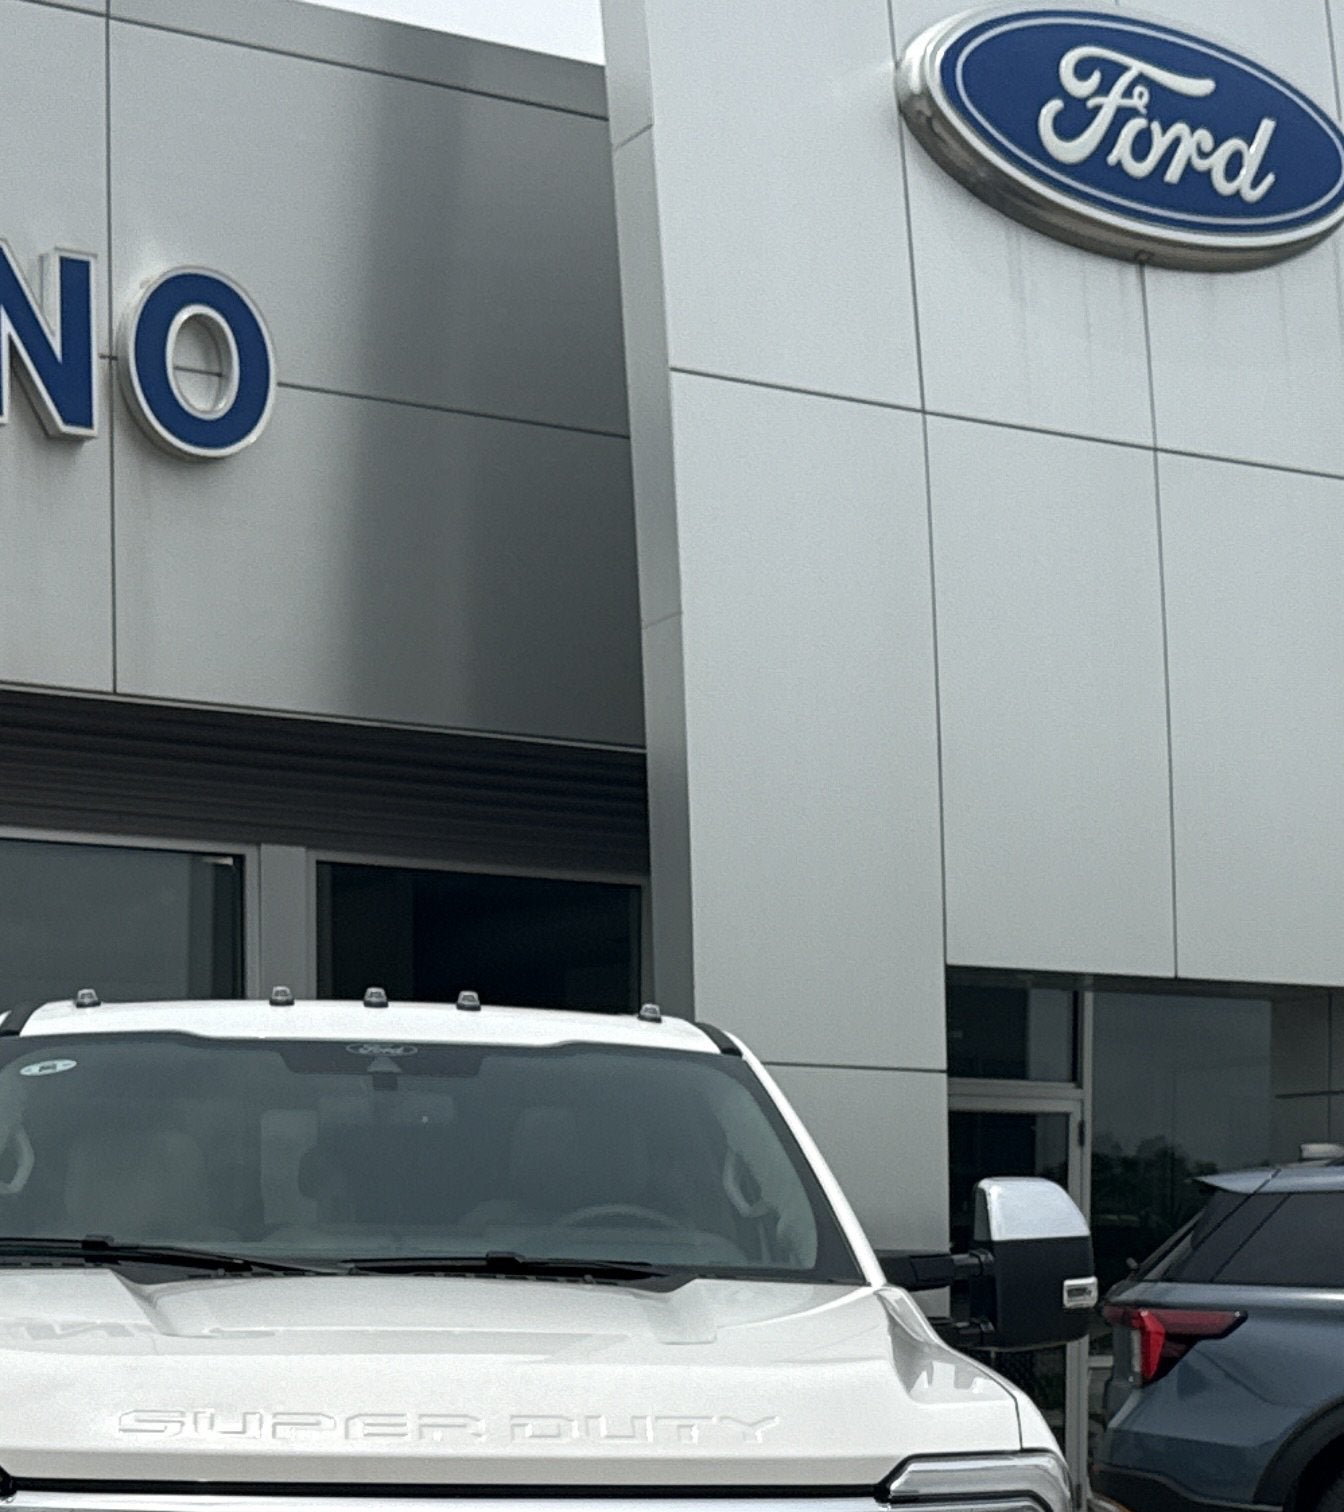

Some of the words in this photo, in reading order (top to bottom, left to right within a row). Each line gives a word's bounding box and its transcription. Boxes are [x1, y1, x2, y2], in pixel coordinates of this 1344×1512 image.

[1038, 46, 1277, 203] Ford
[119, 1409, 486, 1441] SUPER
[511, 1412, 779, 1443] DUTY
